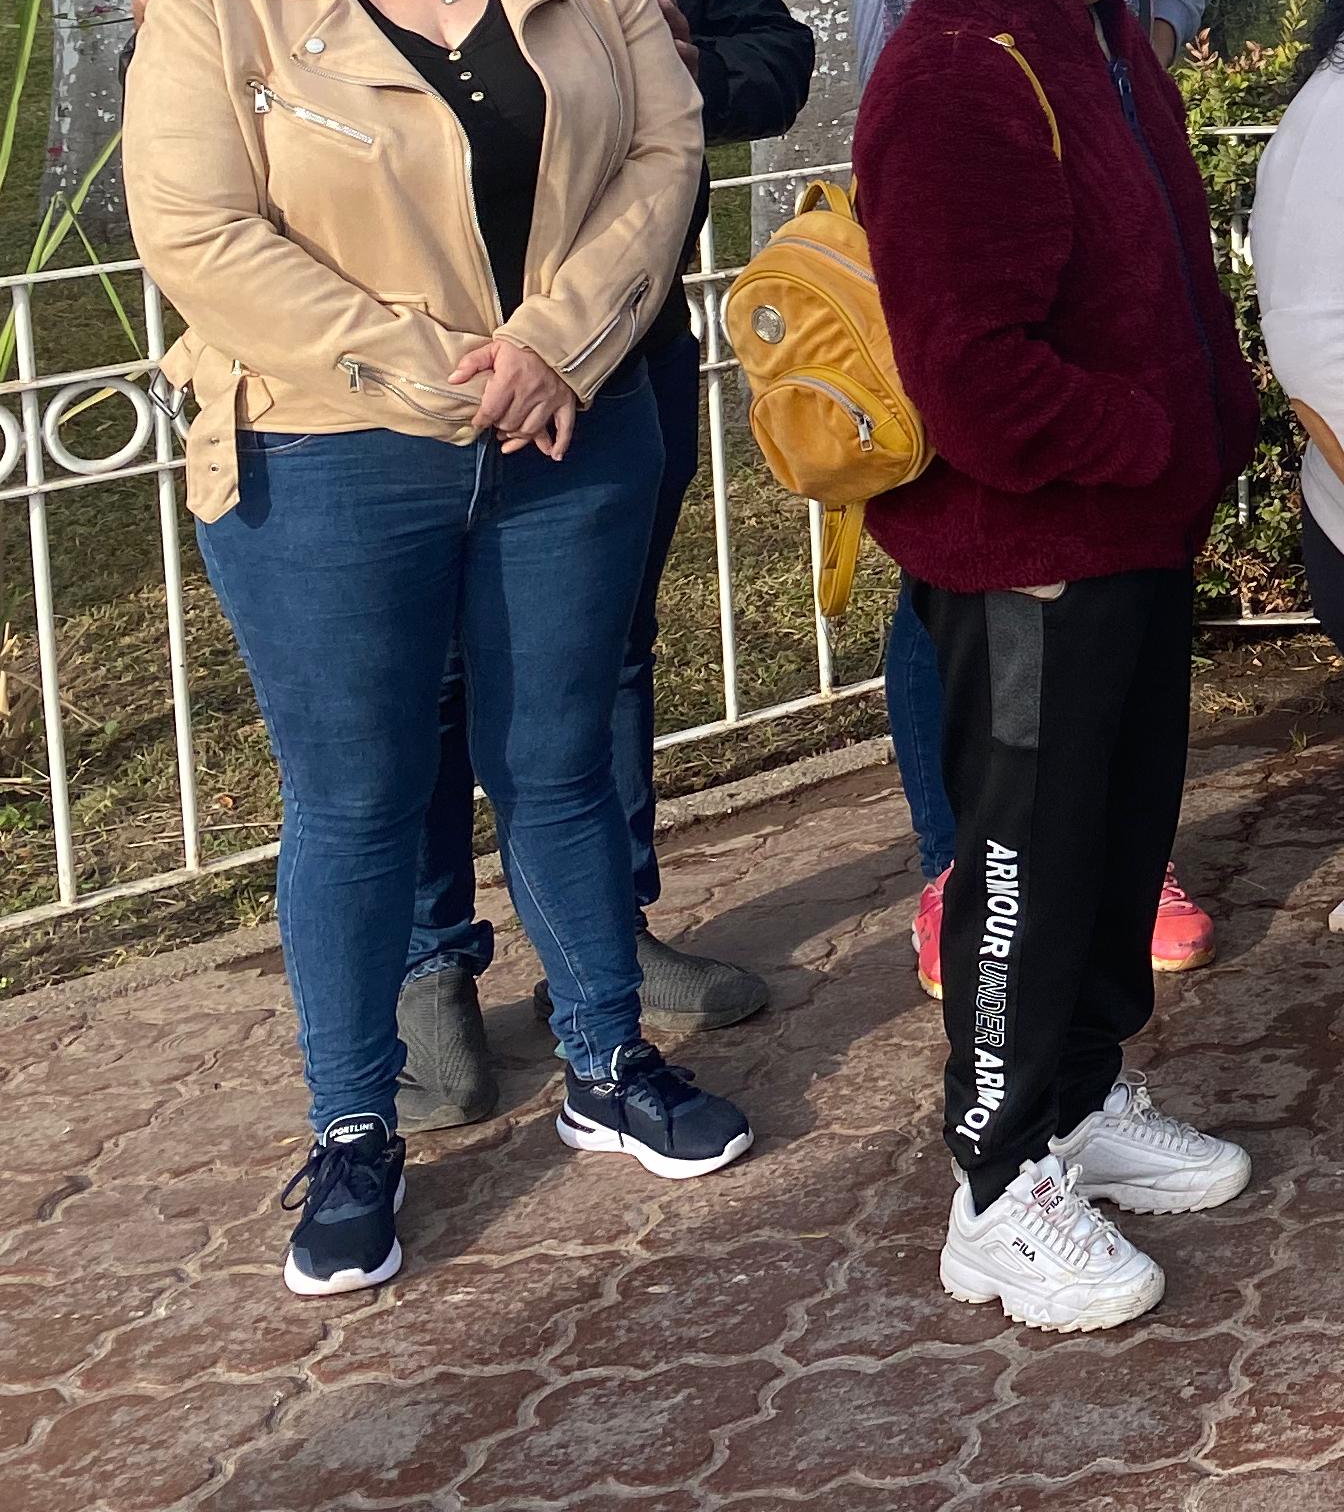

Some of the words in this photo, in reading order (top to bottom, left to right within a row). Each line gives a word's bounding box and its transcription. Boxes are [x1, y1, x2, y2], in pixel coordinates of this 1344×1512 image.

[978, 839, 1018, 956] ARMOUR
[974, 960, 1008, 1048] UNDER
[1012, 1236, 1036, 1262] FILA
